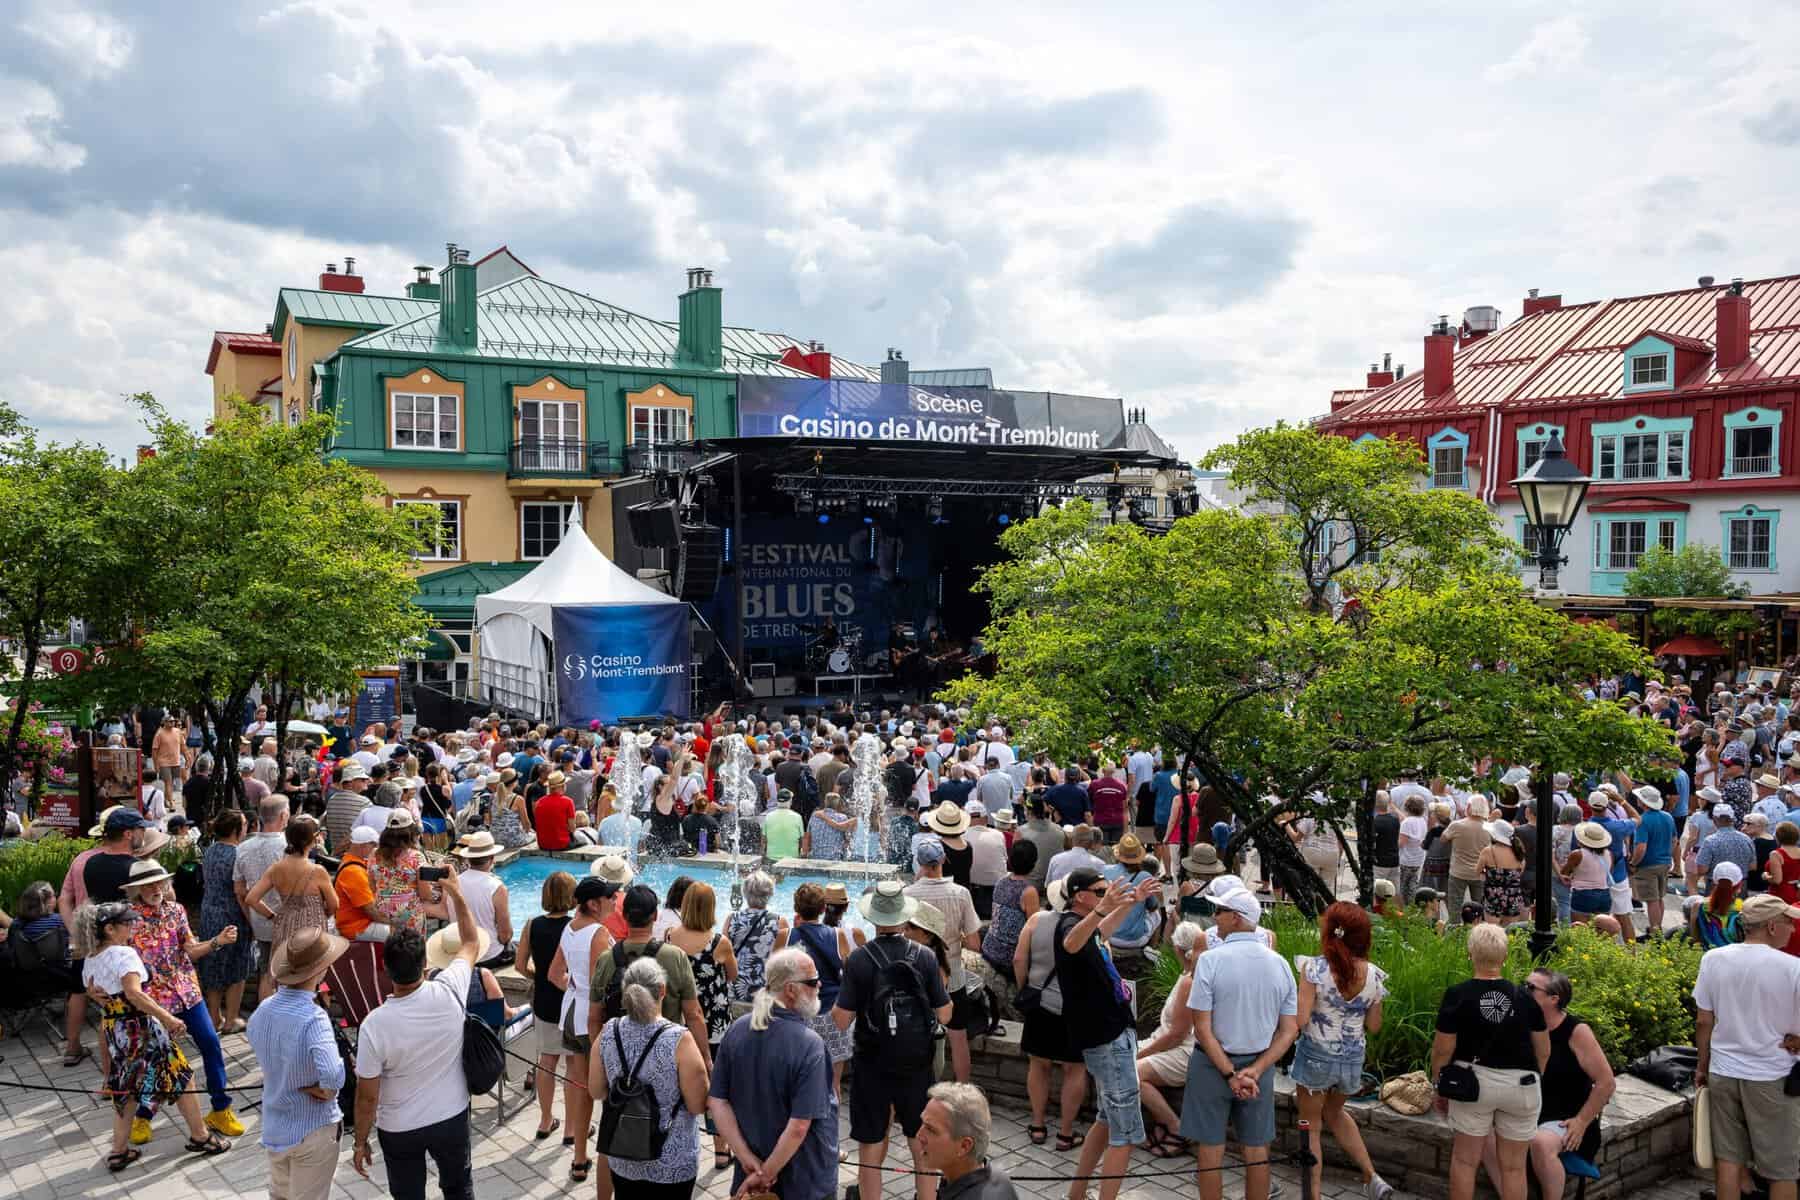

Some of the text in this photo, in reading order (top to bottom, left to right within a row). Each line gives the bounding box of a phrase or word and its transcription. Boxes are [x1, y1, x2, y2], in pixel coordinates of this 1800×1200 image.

[917, 393, 983, 413] Scène
[780, 413, 1099, 449] Casino de Mont-Tremblant
[742, 567, 851, 578] NTERNATIONAL DU
[742, 583, 855, 618] BLUES
[591, 652, 642, 667] Casino
[591, 663, 684, 679] Mont-Tremblant
